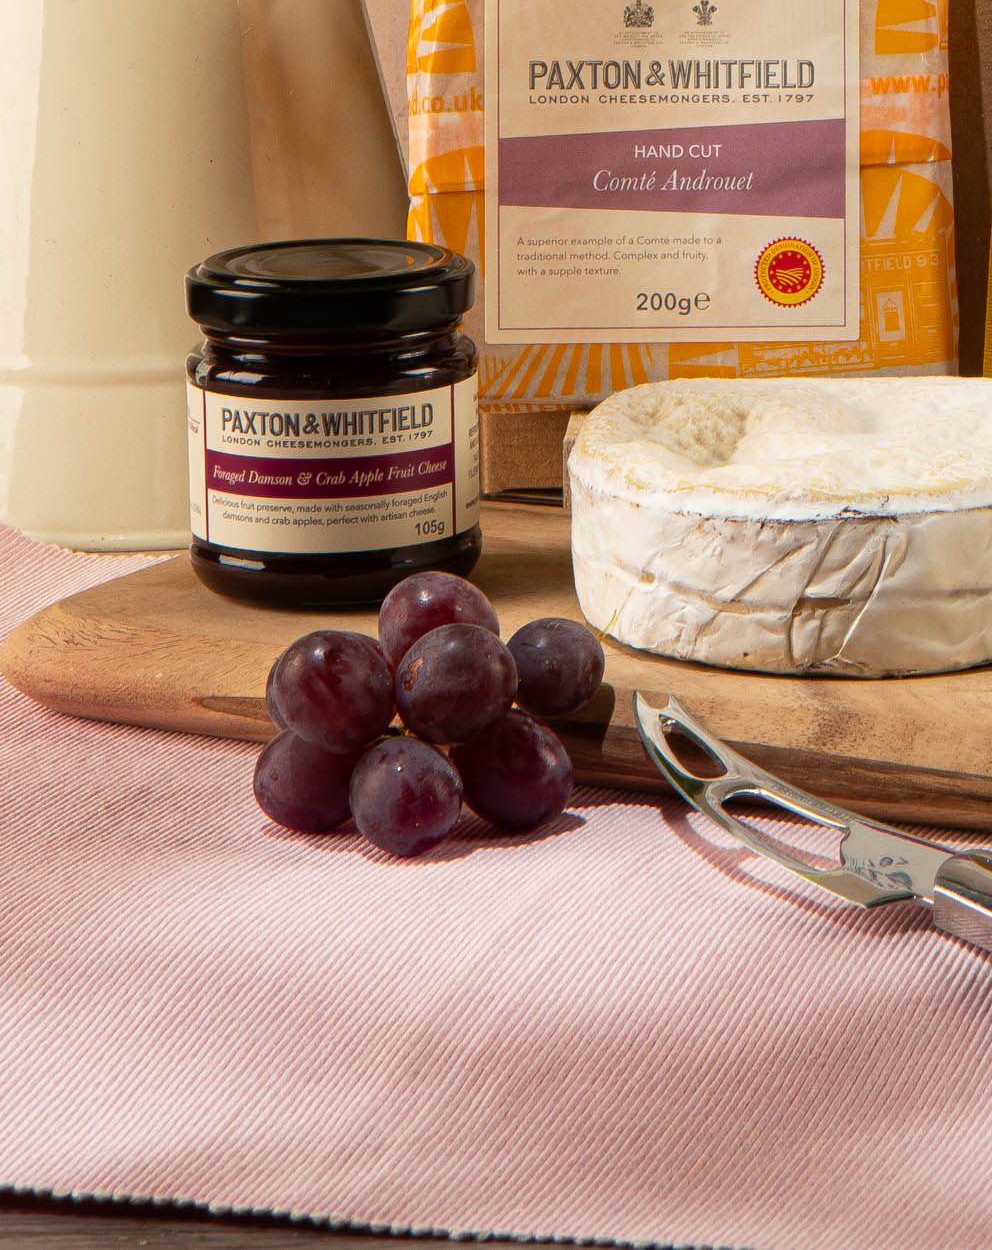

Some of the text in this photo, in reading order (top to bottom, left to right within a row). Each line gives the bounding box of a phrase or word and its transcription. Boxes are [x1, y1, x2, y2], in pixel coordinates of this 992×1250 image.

[529, 94, 815, 104] LONDON CHEESEMONGERS. EST. 1797
[635, 144, 722, 158] HAND CUT
[593, 169, 753, 191] Comté Androuet
[528, 238, 567, 247] superior
[571, 237, 613, 247] example
[616, 237, 626, 245] of
[673, 236, 700, 244] made
[517, 252, 566, 261] traditional
[570, 252, 610, 260] method.
[614, 251, 657, 262] Complex
[661, 251, 679, 260] and
[517, 267, 537, 275] with
[549, 267, 582, 278] supple
[222, 435, 260, 447] LONDON
[383, 435, 405, 444] EST.
[409, 430, 433, 441] 1797
[213, 460, 448, 486] Foraged Damson & Crab Apple Fruit Cheese
[212, 494, 239, 508] Delicious
[241, 501, 254, 510] fruit
[297, 504, 321, 512] made
[325, 502, 344, 511] with
[345, 500, 390, 510] seasonally
[392, 495, 422, 507] foraged
[424, 490, 447, 502] English
[223, 511, 253, 522] damsons
[255, 516, 269, 524] and
[272, 517, 290, 525] crab
[327, 515, 358, 527] perfect
[360, 514, 378, 523] with
[381, 511, 407, 521] artisan
[415, 519, 445, 536] 105g
